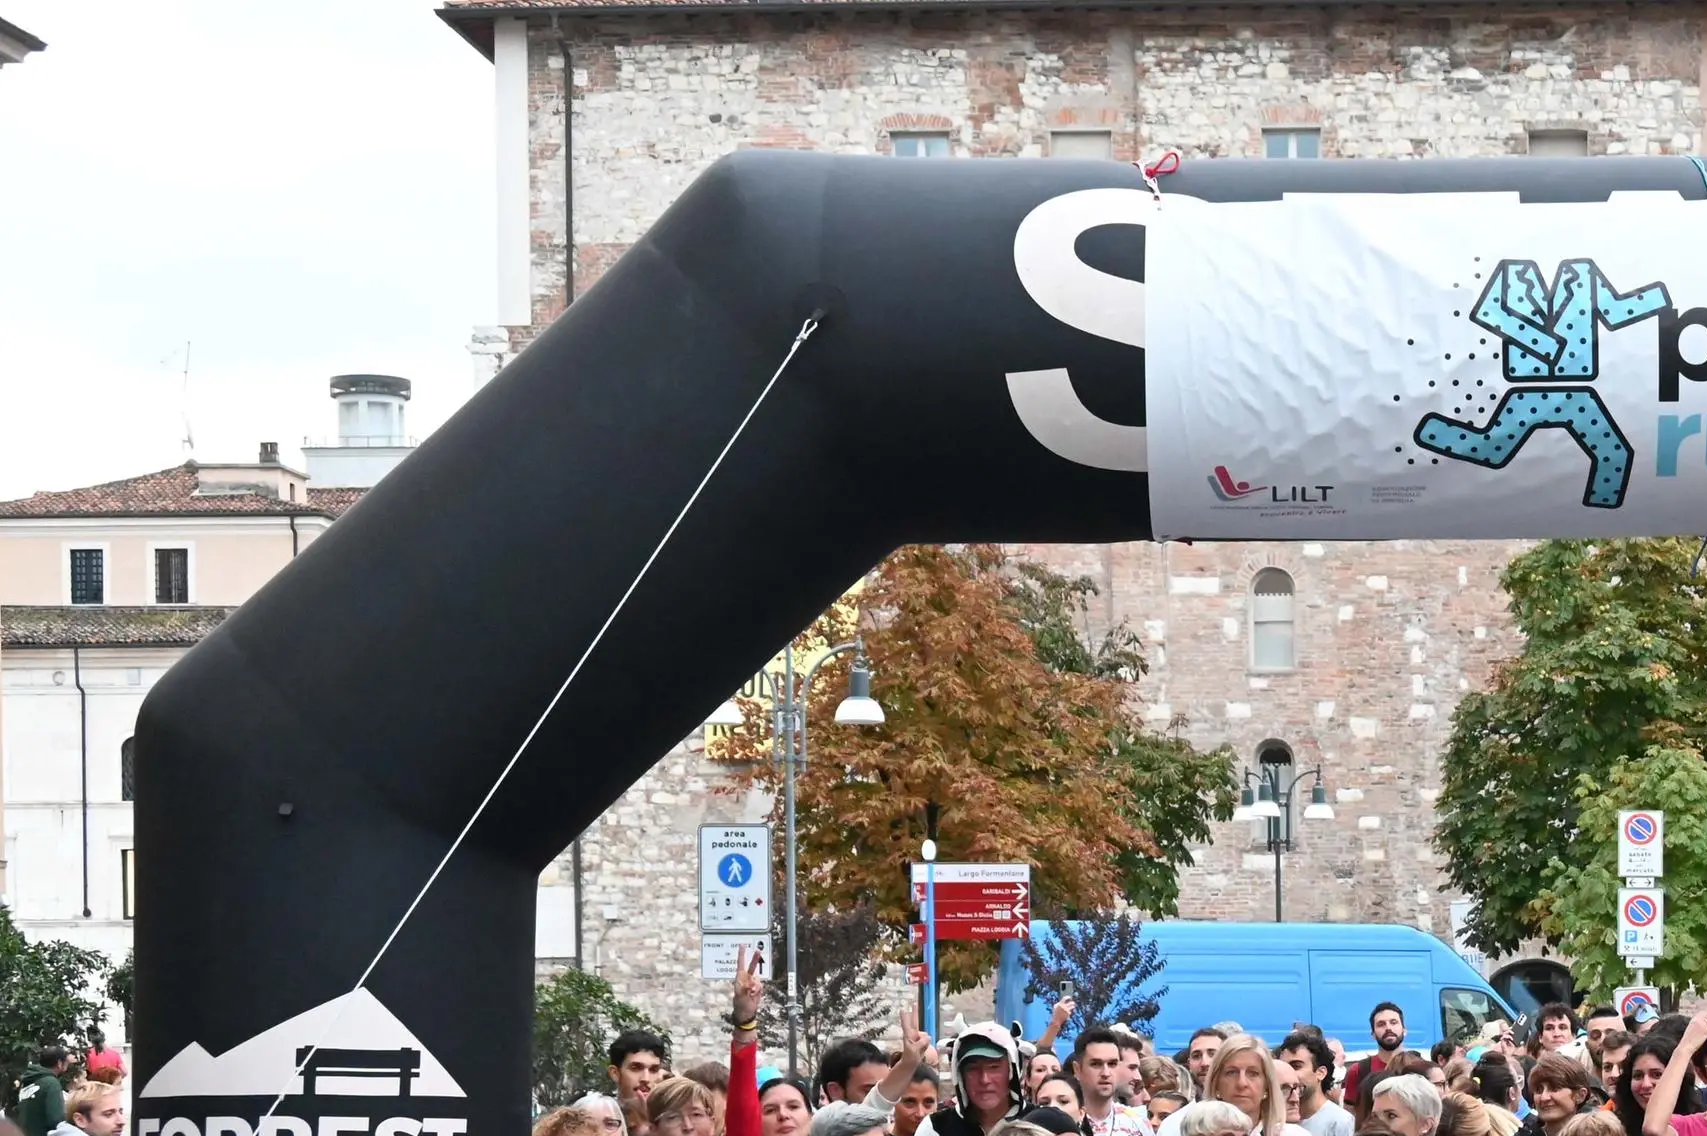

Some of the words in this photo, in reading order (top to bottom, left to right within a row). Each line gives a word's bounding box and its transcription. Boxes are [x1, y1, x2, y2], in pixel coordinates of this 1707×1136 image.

[1272, 485, 1335, 502] LILT
[724, 830, 746, 838] area
[711, 840, 758, 849] pedonale
[958, 869, 980, 878] Largo
